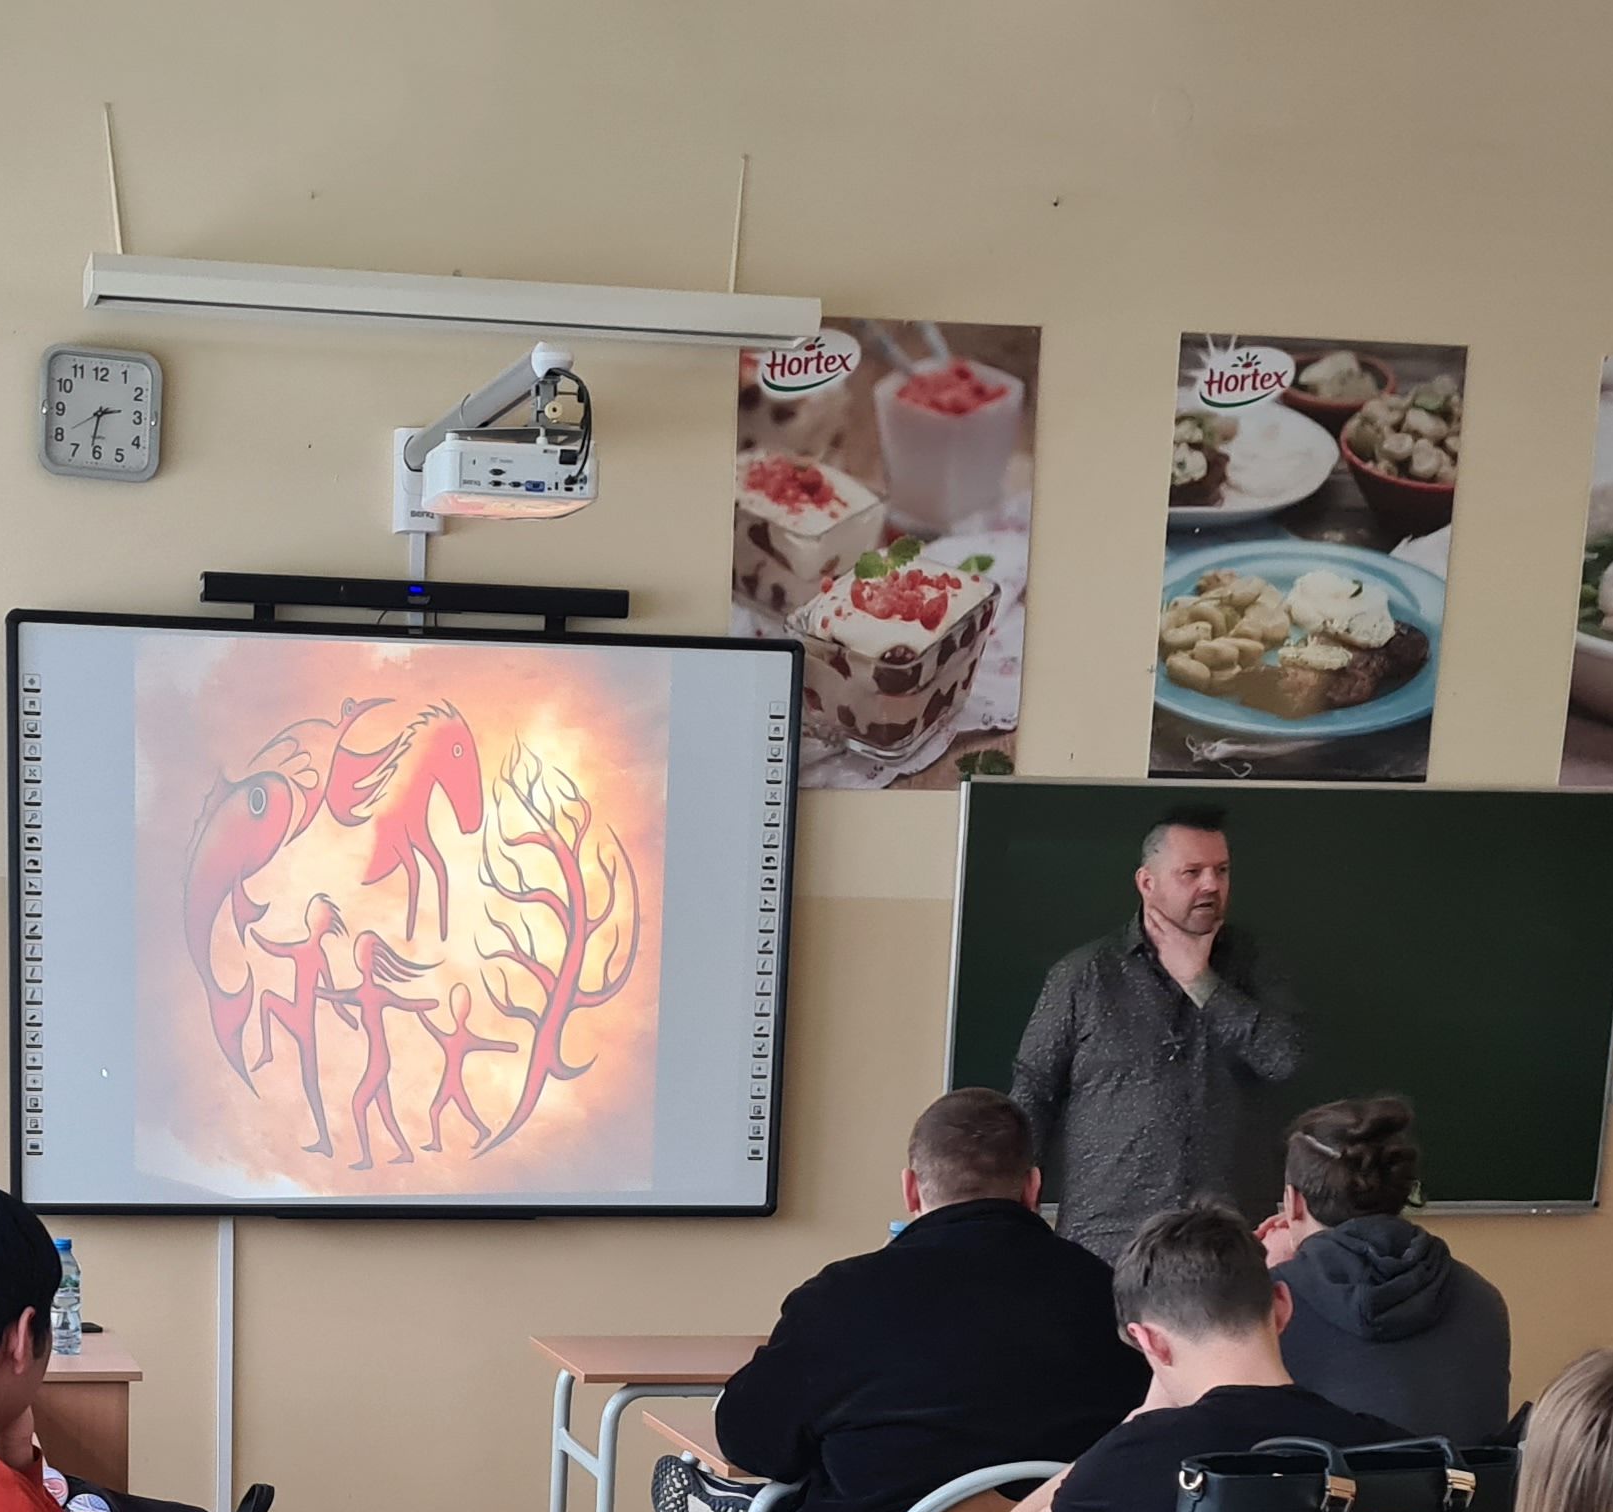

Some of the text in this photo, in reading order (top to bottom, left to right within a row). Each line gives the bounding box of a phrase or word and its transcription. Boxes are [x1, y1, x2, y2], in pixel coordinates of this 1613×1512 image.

[764, 347, 854, 379] Hortex
[72, 364, 84, 379] 11
[92, 366, 110, 382] 12
[121, 369, 128, 384] 1
[56, 377, 73, 394] 10
[1203, 367, 1292, 396] Hortex
[133, 386, 144, 402] 2
[55, 401, 66, 416] 9
[132, 410, 143, 425] 3
[54, 427, 64, 442] 8
[70, 443, 80, 457] 7
[131, 435, 141, 450] 4
[92, 445, 102, 460] 6
[114, 448, 125, 463] 5
